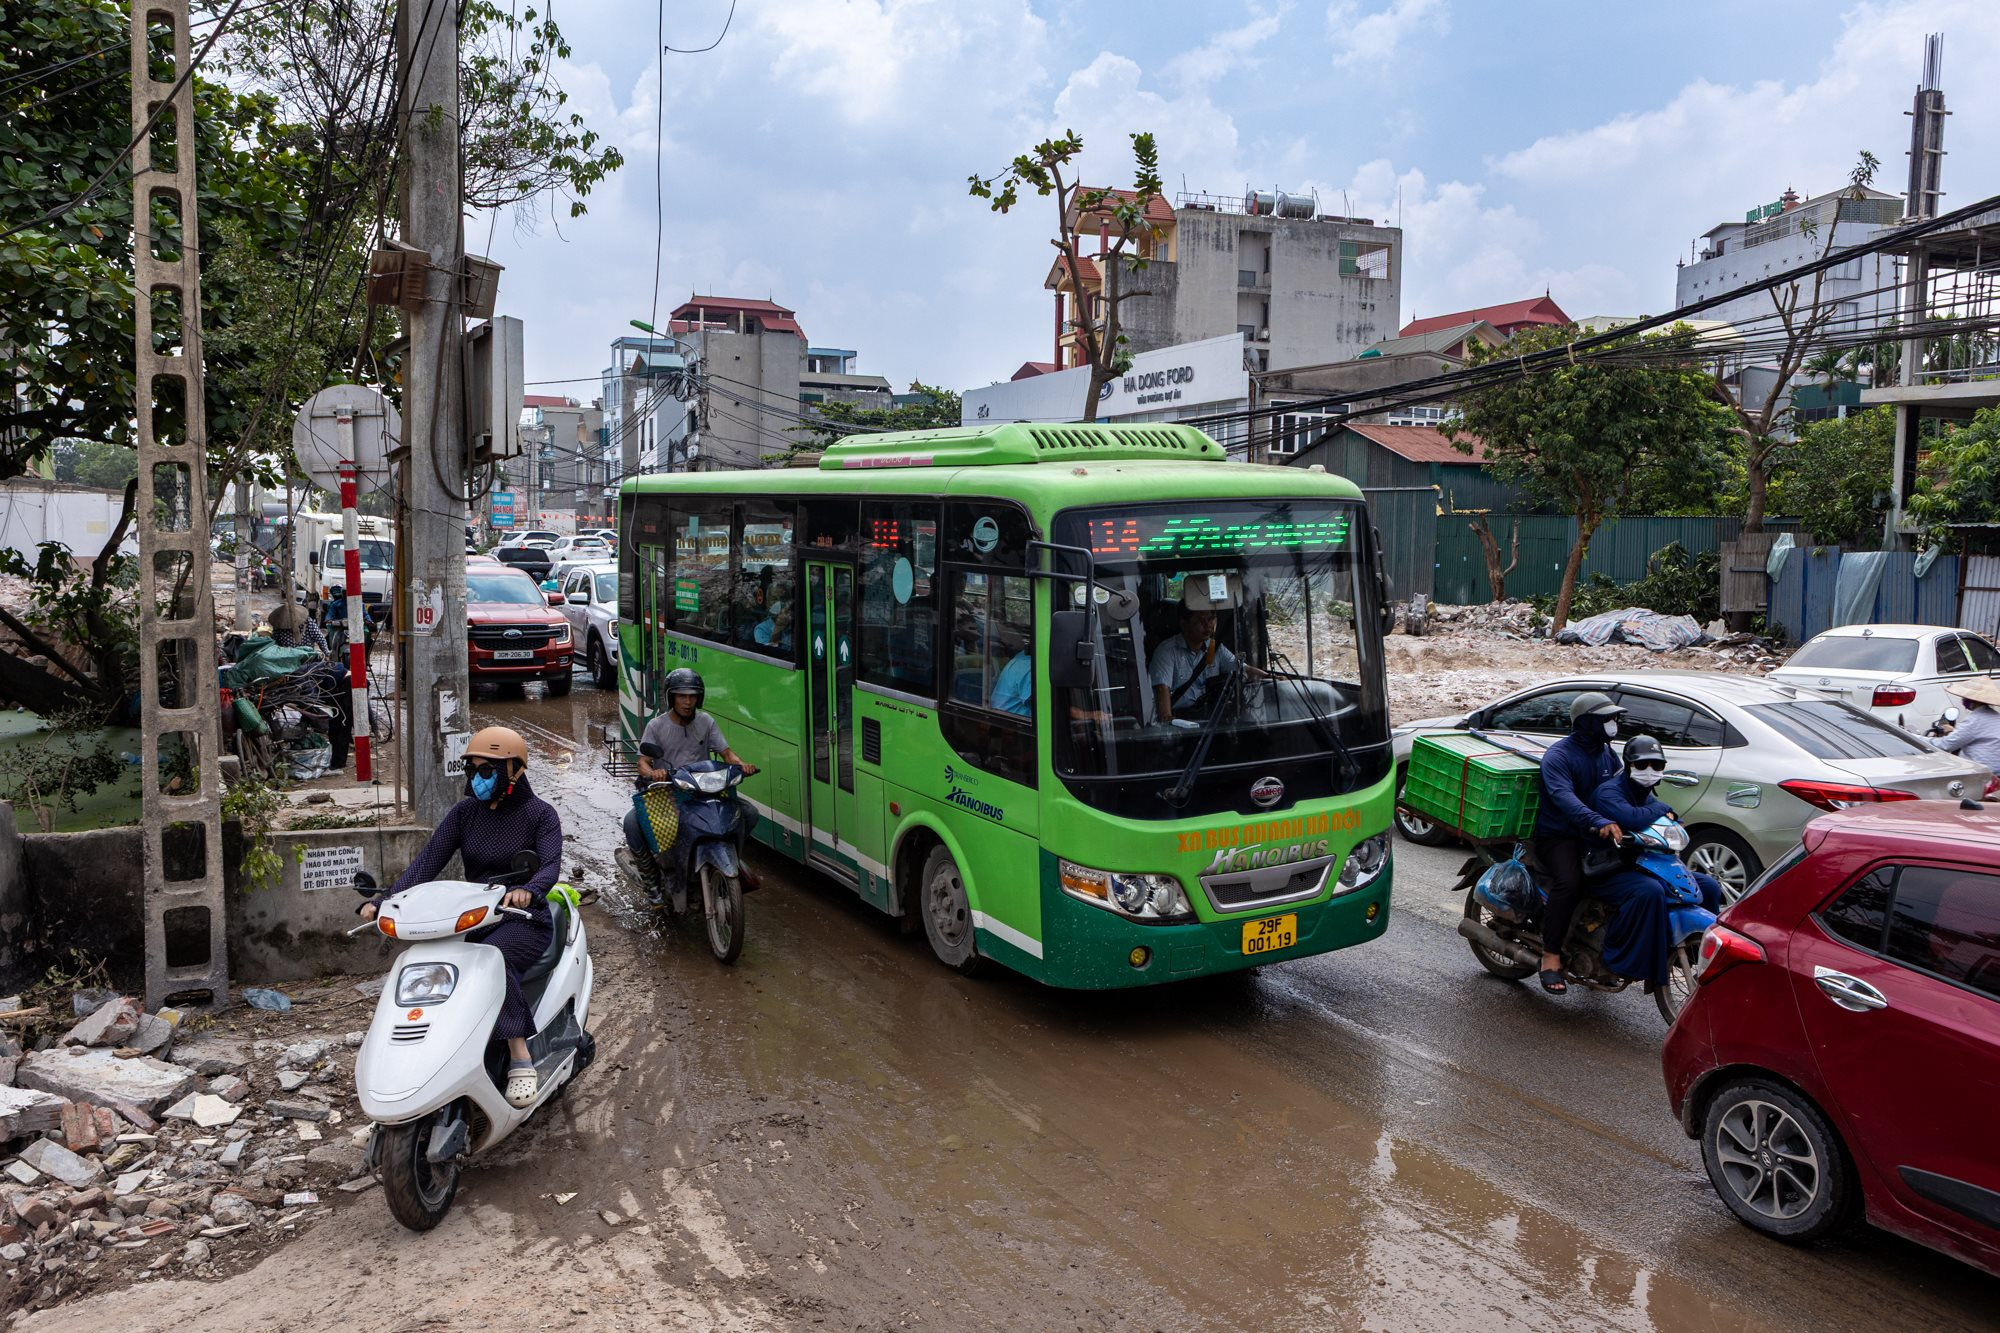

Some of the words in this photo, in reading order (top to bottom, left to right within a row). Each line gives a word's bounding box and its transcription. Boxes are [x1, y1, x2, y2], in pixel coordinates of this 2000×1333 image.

[1123, 375, 1137, 393] HA
[1138, 371, 1166, 390] DONG
[1166, 366, 1194, 386] FORD
[416, 607, 433, 625] 09
[945, 786, 1004, 821] HANOIBUS
[1177, 831, 1203, 853] XN
[1205, 827, 1239, 849] BUS
[1243, 818, 1303, 845] NHANH
[1306, 811, 1328, 836] HÀ
[1331, 806, 1361, 834] NỘI
[327, 849, 337, 857] THI
[338, 847, 356, 856] CÔNG
[1197, 839, 1329, 877] HANOIBUS
[316, 879, 332, 888] 0971
[334, 877, 348, 886] 932
[326, 869, 339, 877] THEO
[1258, 918, 1282, 935] 29F
[1248, 932, 1291, 952] 001.19
